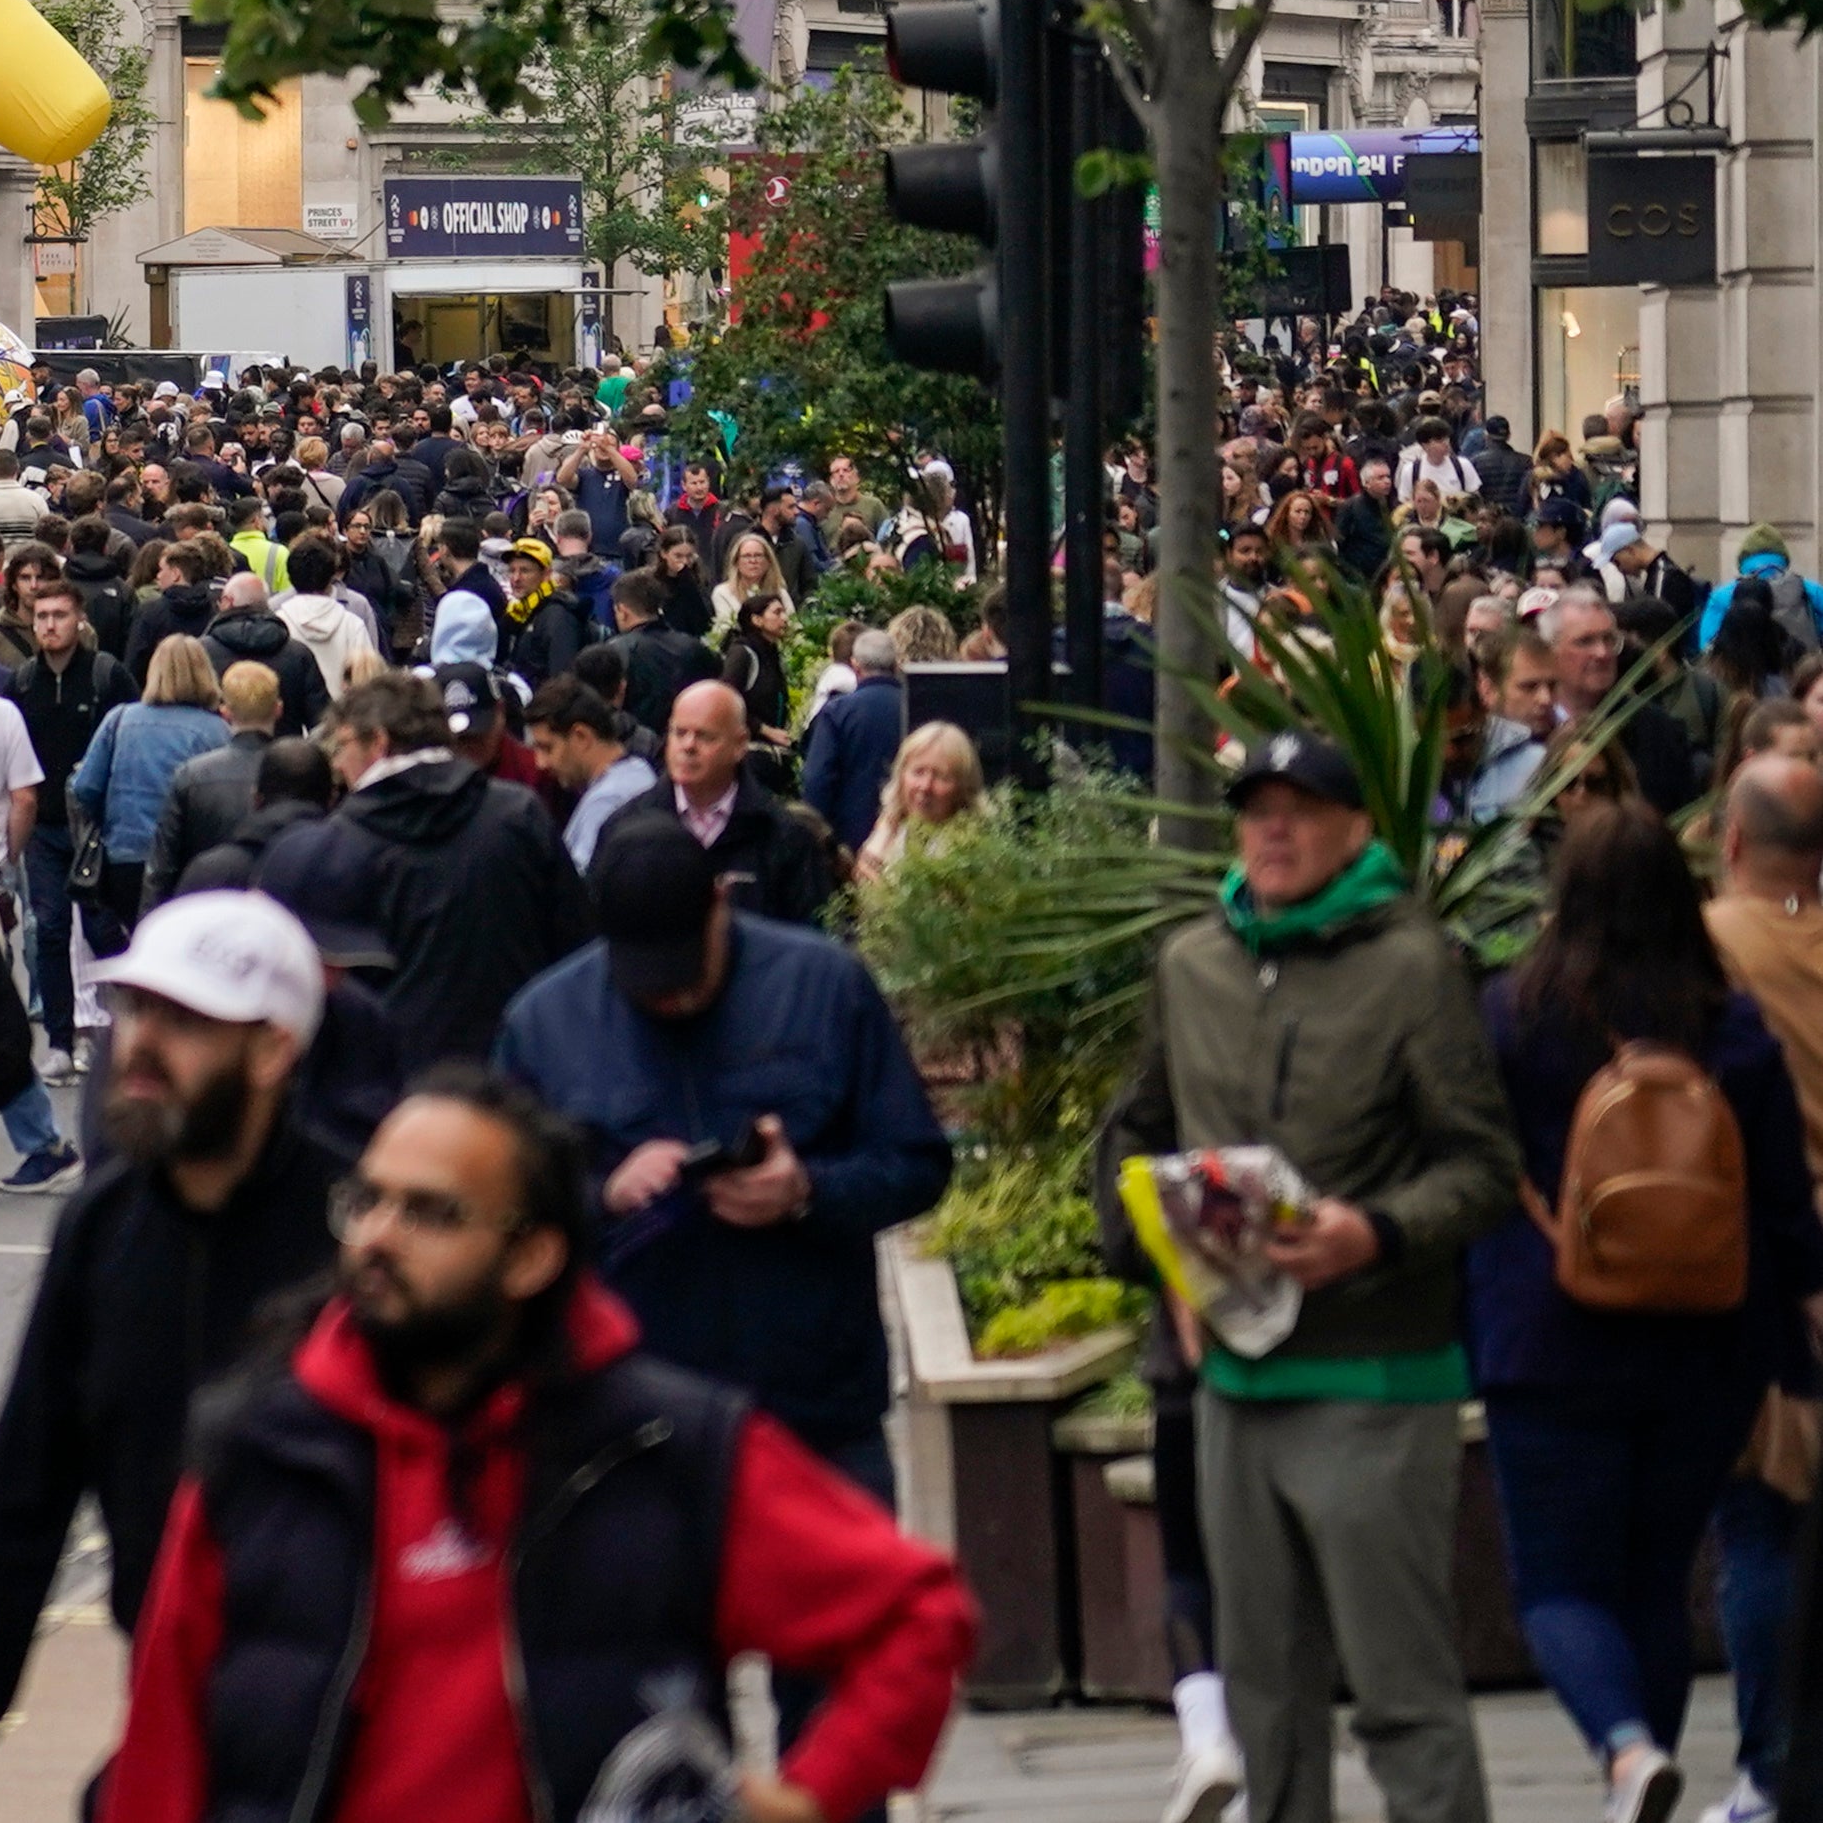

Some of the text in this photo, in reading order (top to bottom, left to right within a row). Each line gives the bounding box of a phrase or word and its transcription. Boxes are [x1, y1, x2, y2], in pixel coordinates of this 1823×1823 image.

[1357, 154, 1386, 176] 24
[307, 207, 343, 218] PRINCES
[307, 218, 338, 228] STREET
[442, 202, 529, 235] OFFICIAL SHOP
[1606, 202, 1700, 237] COS
